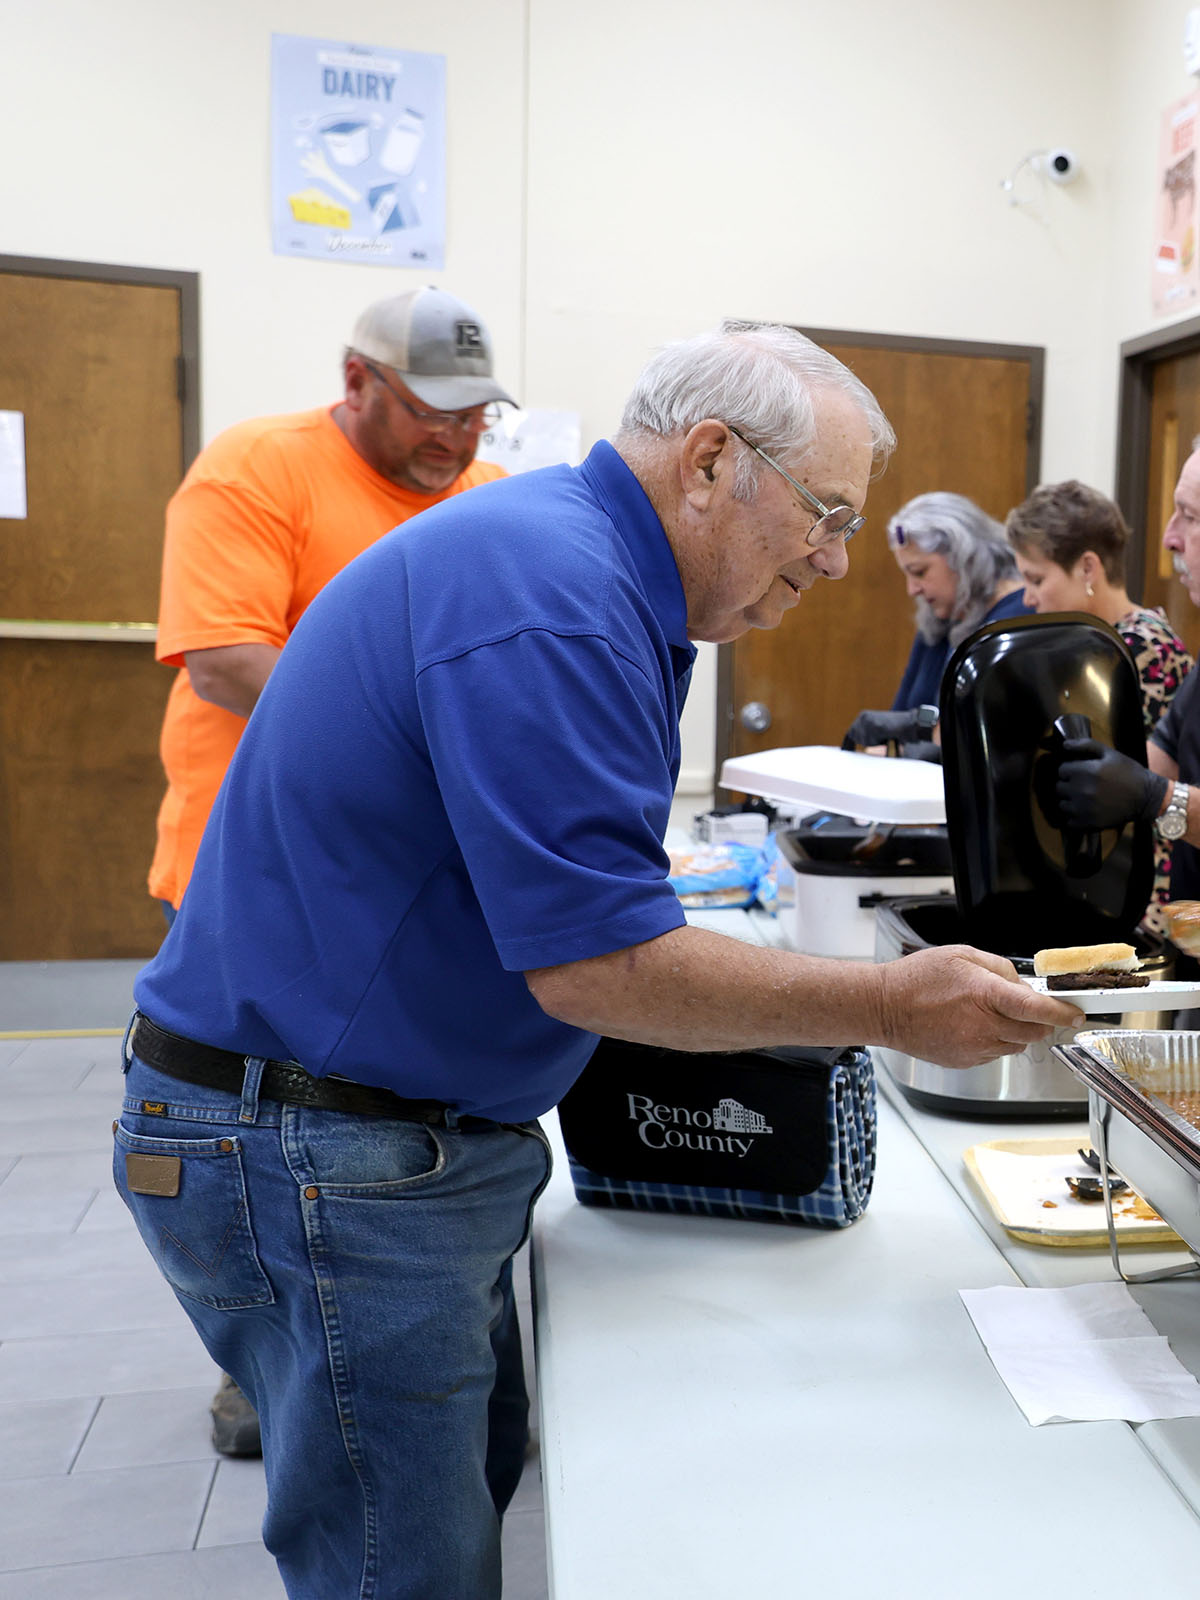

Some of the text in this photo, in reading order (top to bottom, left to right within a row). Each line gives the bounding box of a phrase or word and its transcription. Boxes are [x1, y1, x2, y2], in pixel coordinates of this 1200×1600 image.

[323, 67, 397, 102] DAIRY
[626, 1093, 712, 1128] Reno
[638, 1120, 754, 1158] County
